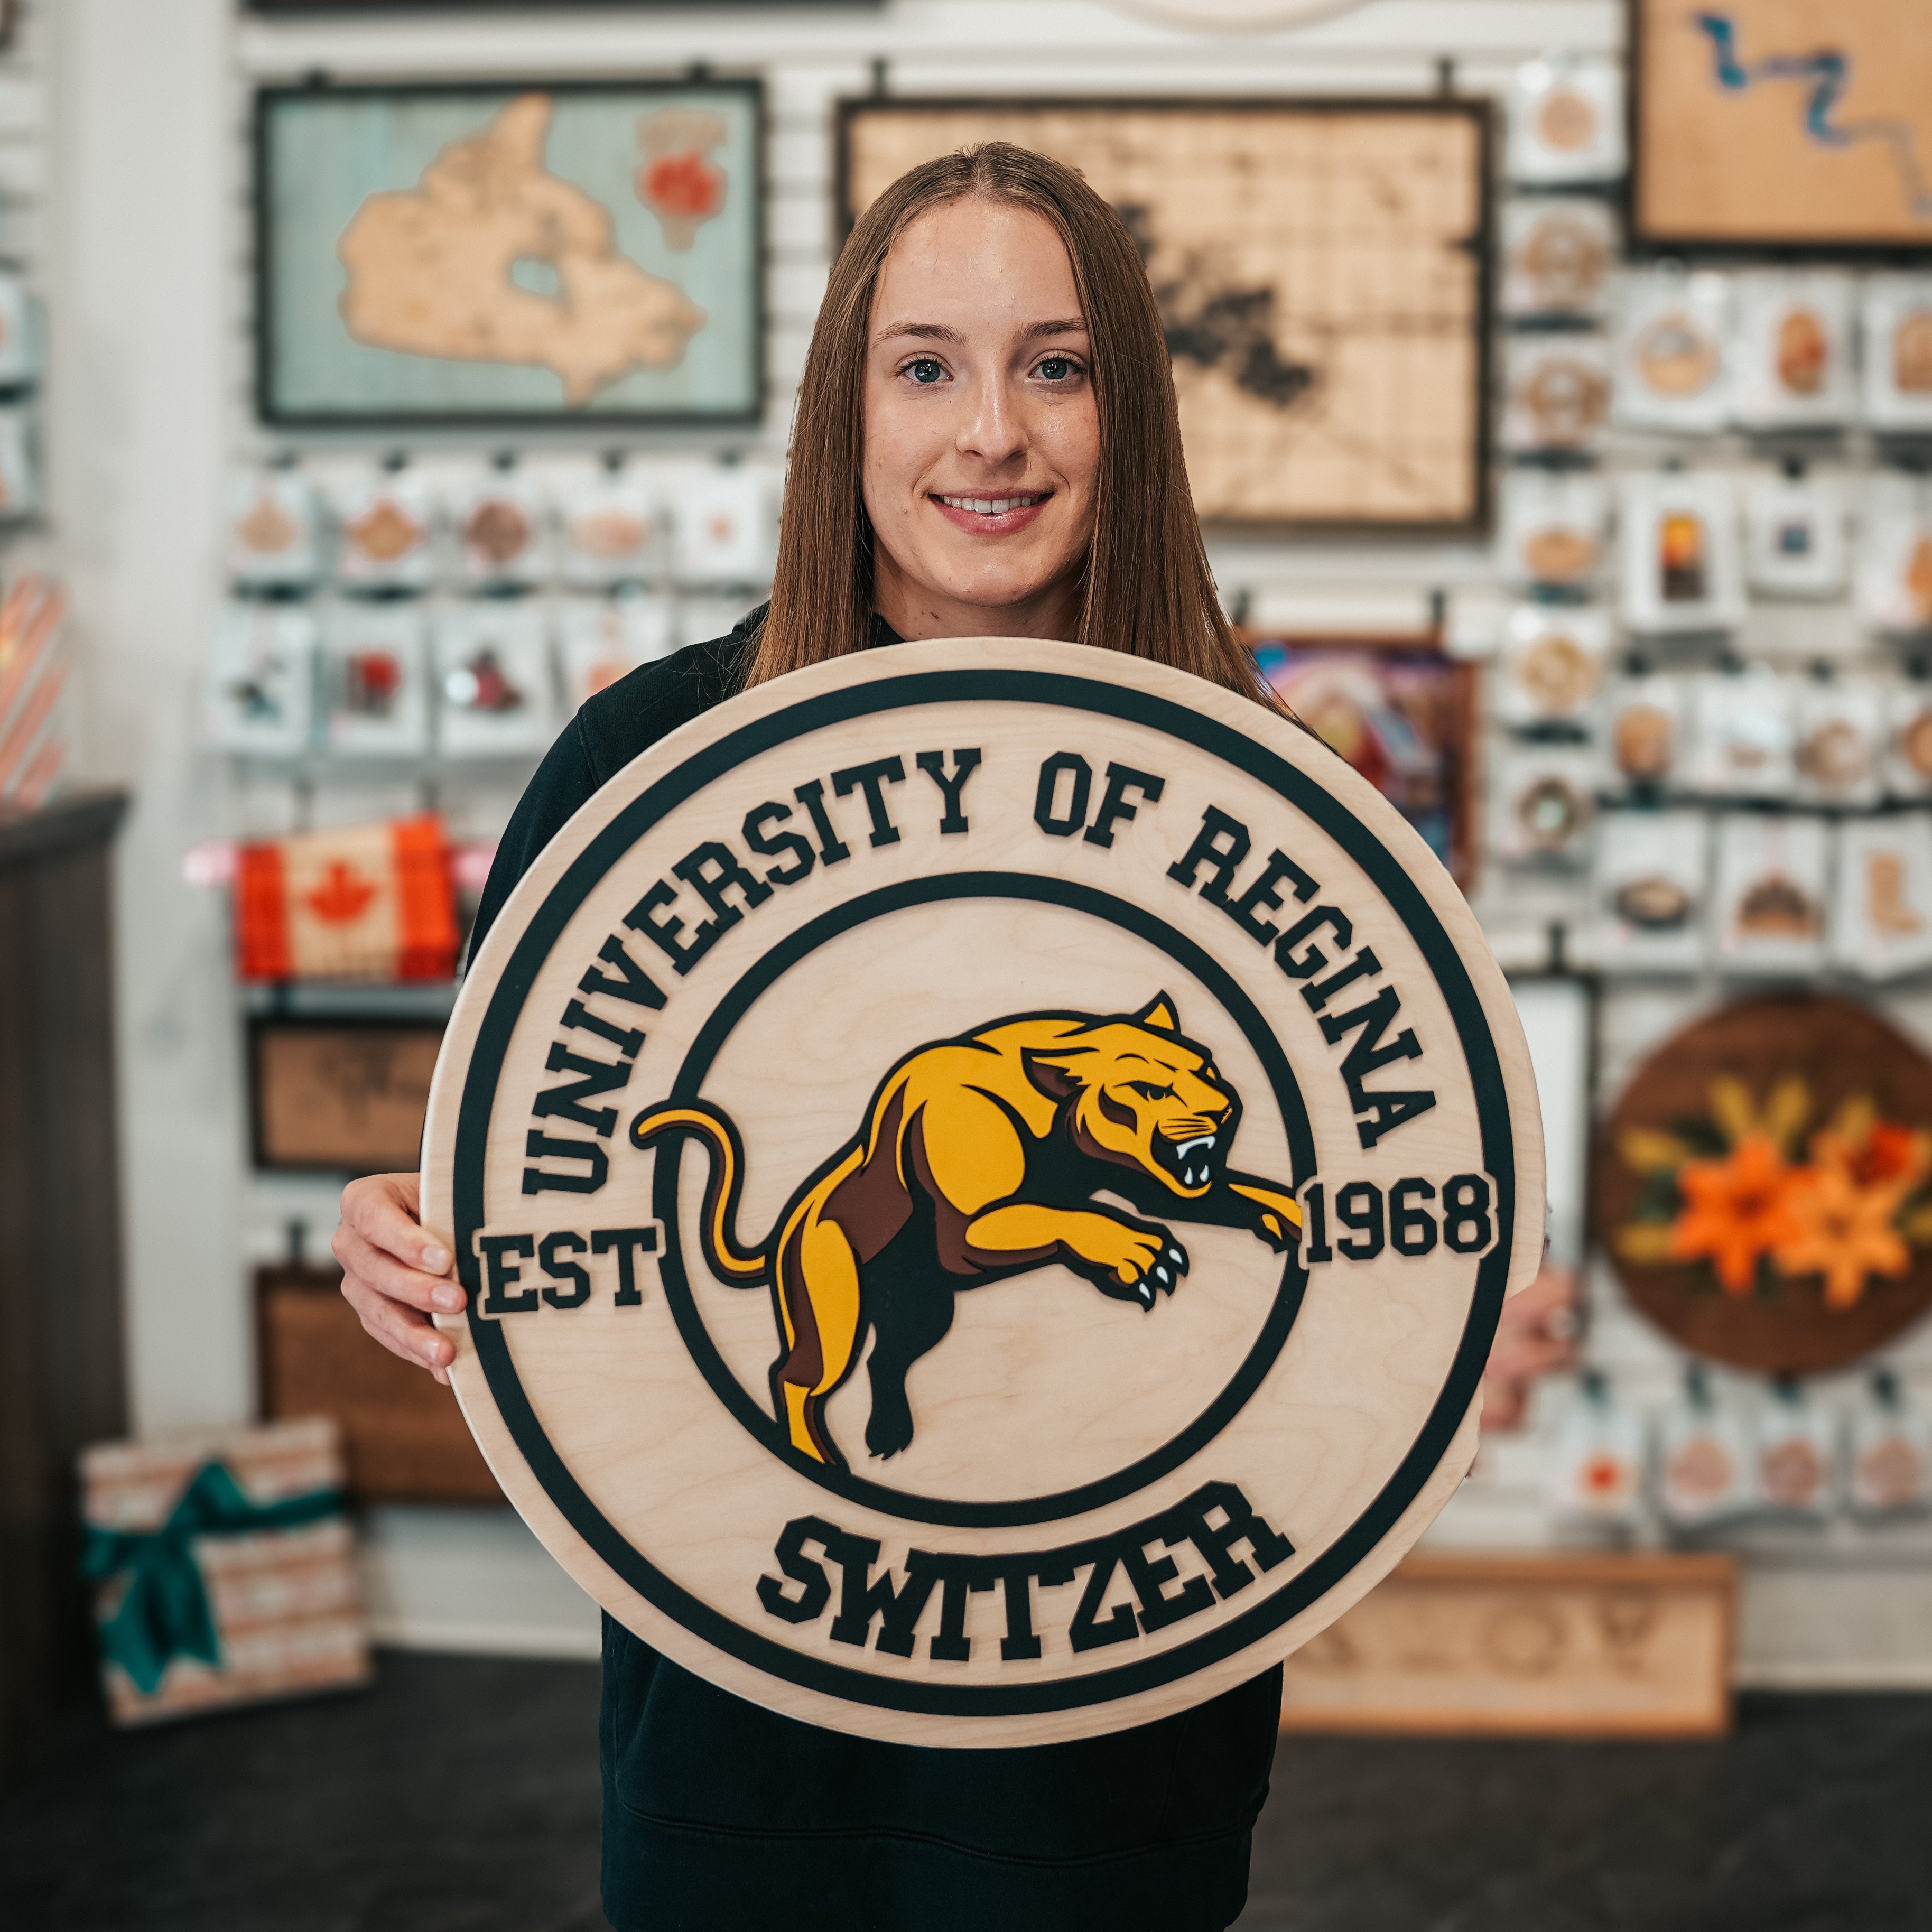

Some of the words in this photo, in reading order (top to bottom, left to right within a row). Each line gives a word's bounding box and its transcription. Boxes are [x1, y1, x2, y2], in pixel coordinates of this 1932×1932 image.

[522, 748, 981, 1195] UNIVERSITY
[1034, 752, 1165, 848] OF
[1167, 805, 1436, 1149] REGINA
[480, 1227, 657, 1313] EST
[1305, 1174, 1491, 1262] 1968
[756, 1481, 1295, 1661] SWITZER
